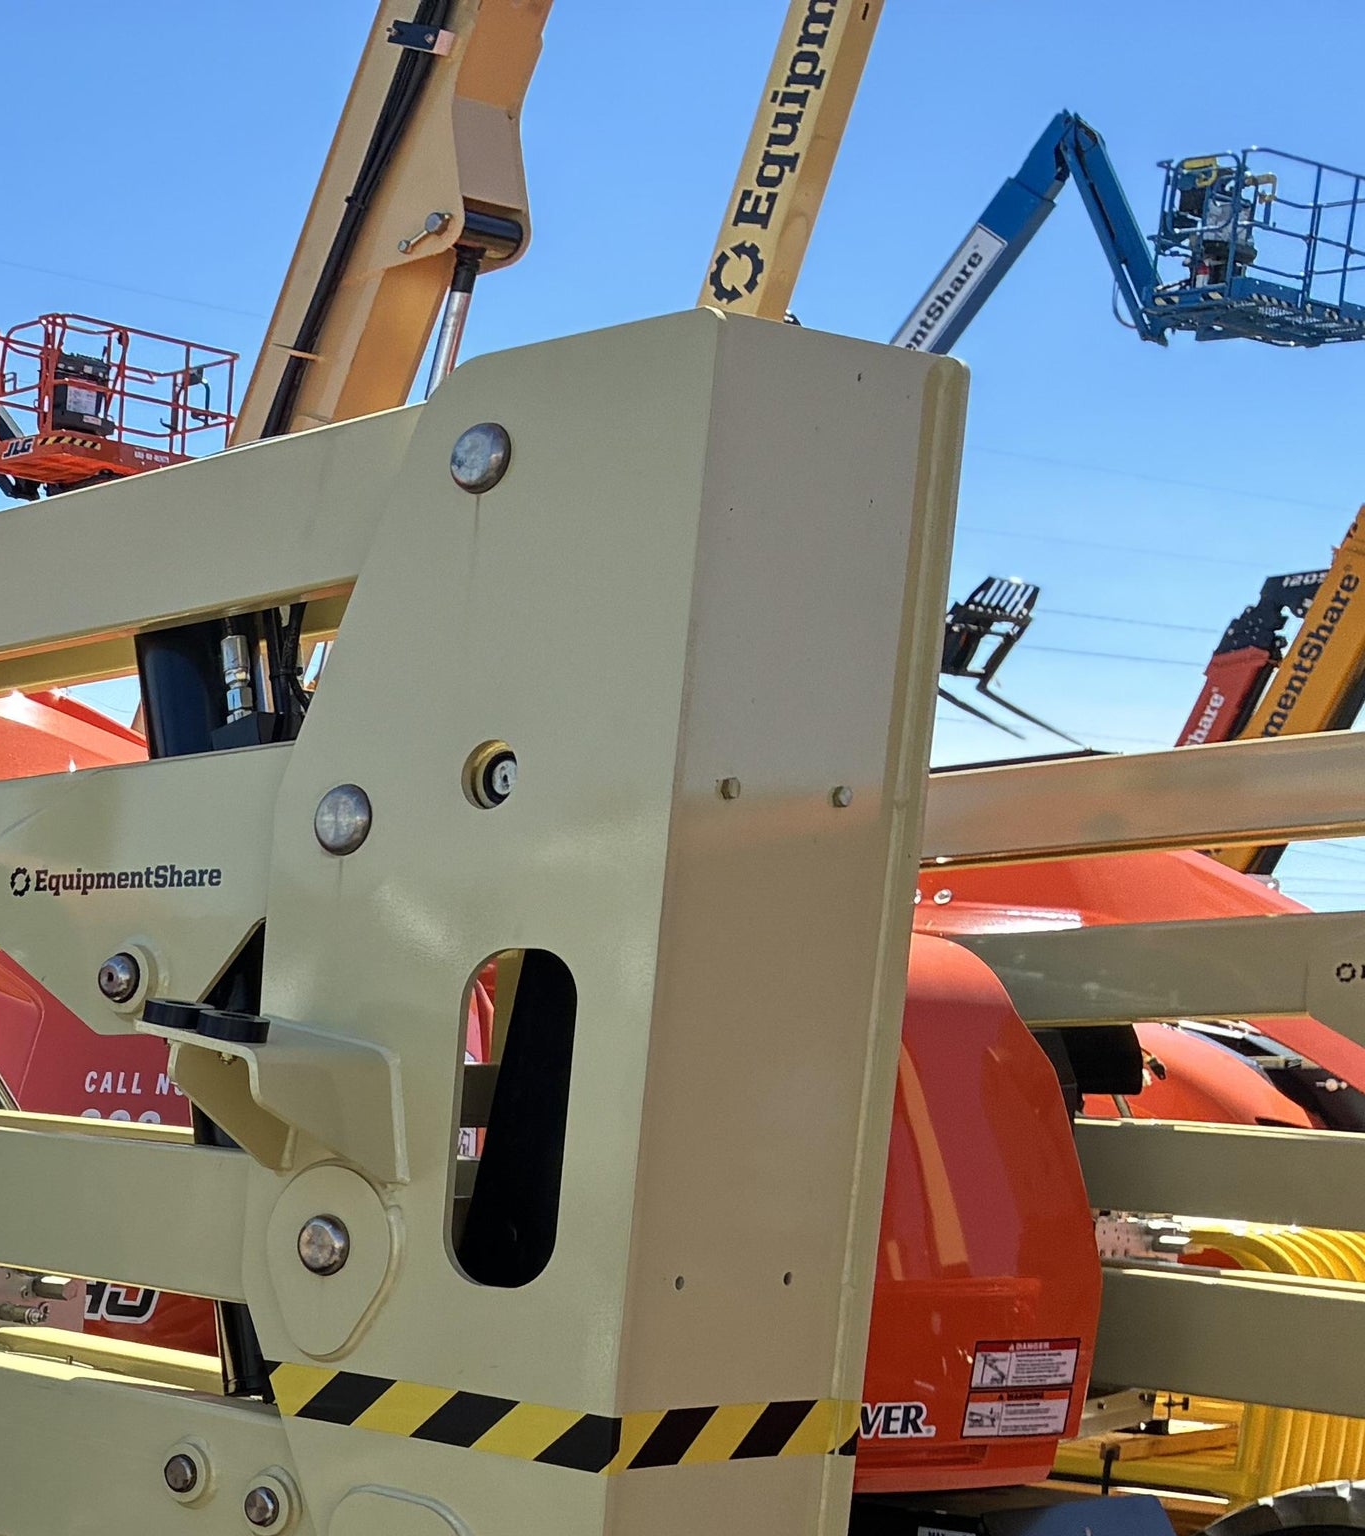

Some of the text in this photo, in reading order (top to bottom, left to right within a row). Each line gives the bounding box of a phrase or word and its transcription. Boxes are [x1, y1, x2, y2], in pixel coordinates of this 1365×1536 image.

[4, 439, 33, 458] JLG
[1185, 692, 1225, 746] hare
[34, 864, 222, 896] EquipmentShare
[84, 1070, 142, 1095] CALL
